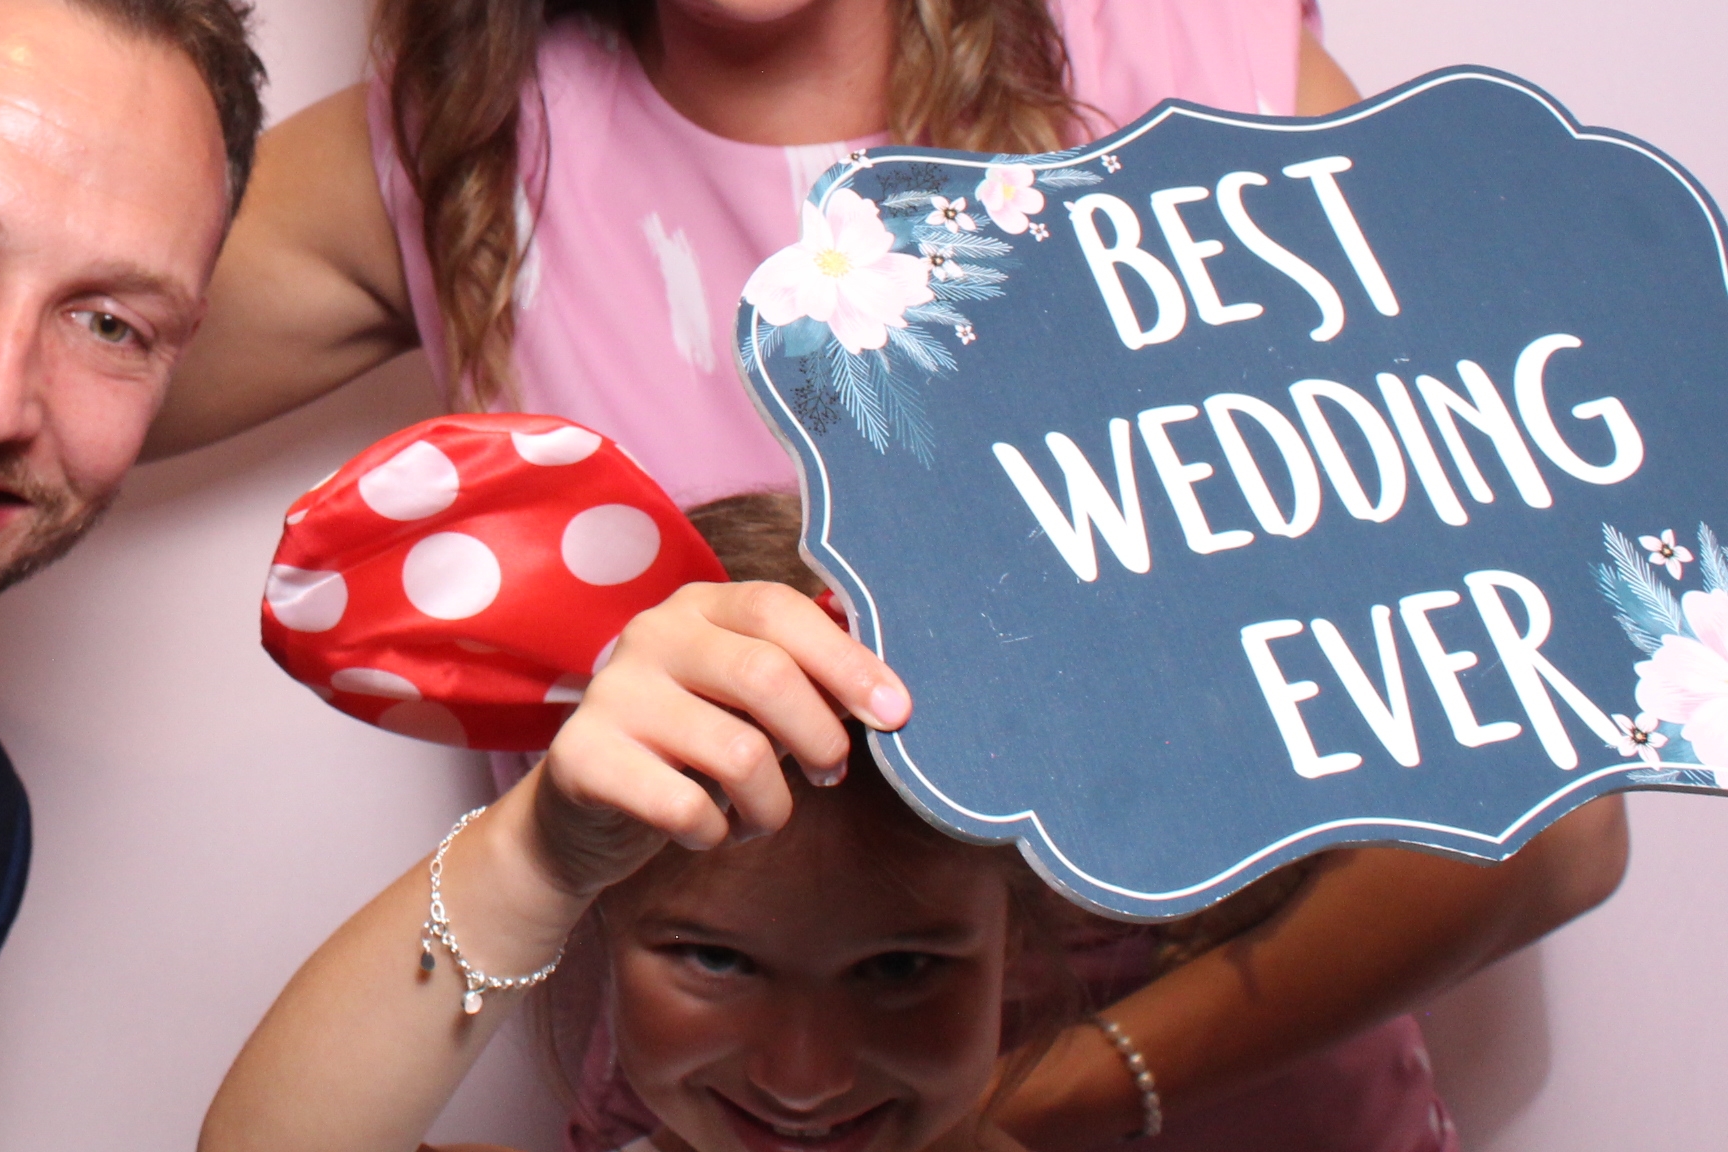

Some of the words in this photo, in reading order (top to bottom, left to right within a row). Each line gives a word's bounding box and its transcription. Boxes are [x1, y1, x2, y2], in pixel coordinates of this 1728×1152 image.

[1071, 156, 1399, 350] BEST
[992, 333, 1644, 582] WEDDING
[1240, 570, 1624, 779] EVER
